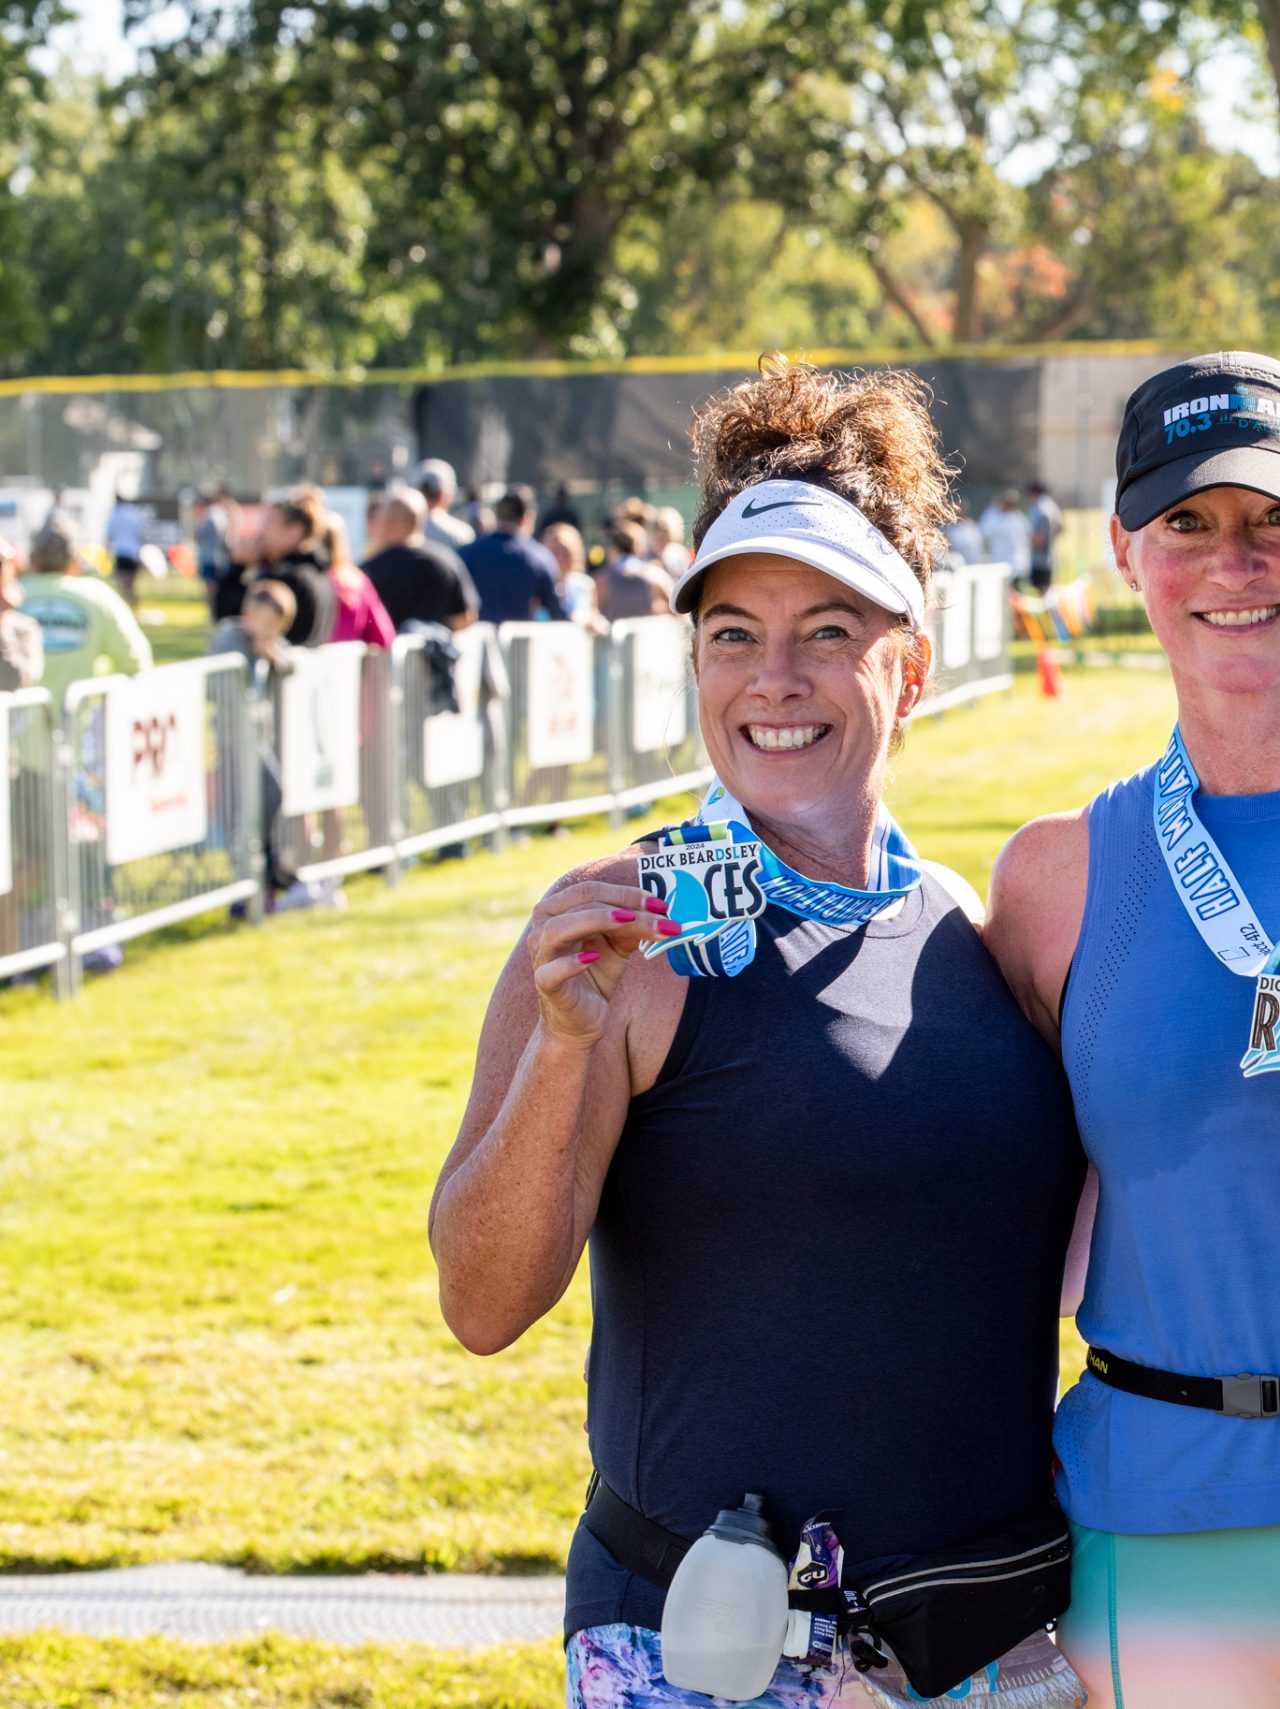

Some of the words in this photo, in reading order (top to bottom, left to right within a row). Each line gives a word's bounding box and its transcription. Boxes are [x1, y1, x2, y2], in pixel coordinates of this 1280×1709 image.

[1164, 413, 1212, 446] 70.3
[640, 853, 676, 870] DICK
[680, 844, 757, 866] BEARDSLEY
[686, 843, 705, 851] 2024
[1174, 841, 1241, 921] HALF
